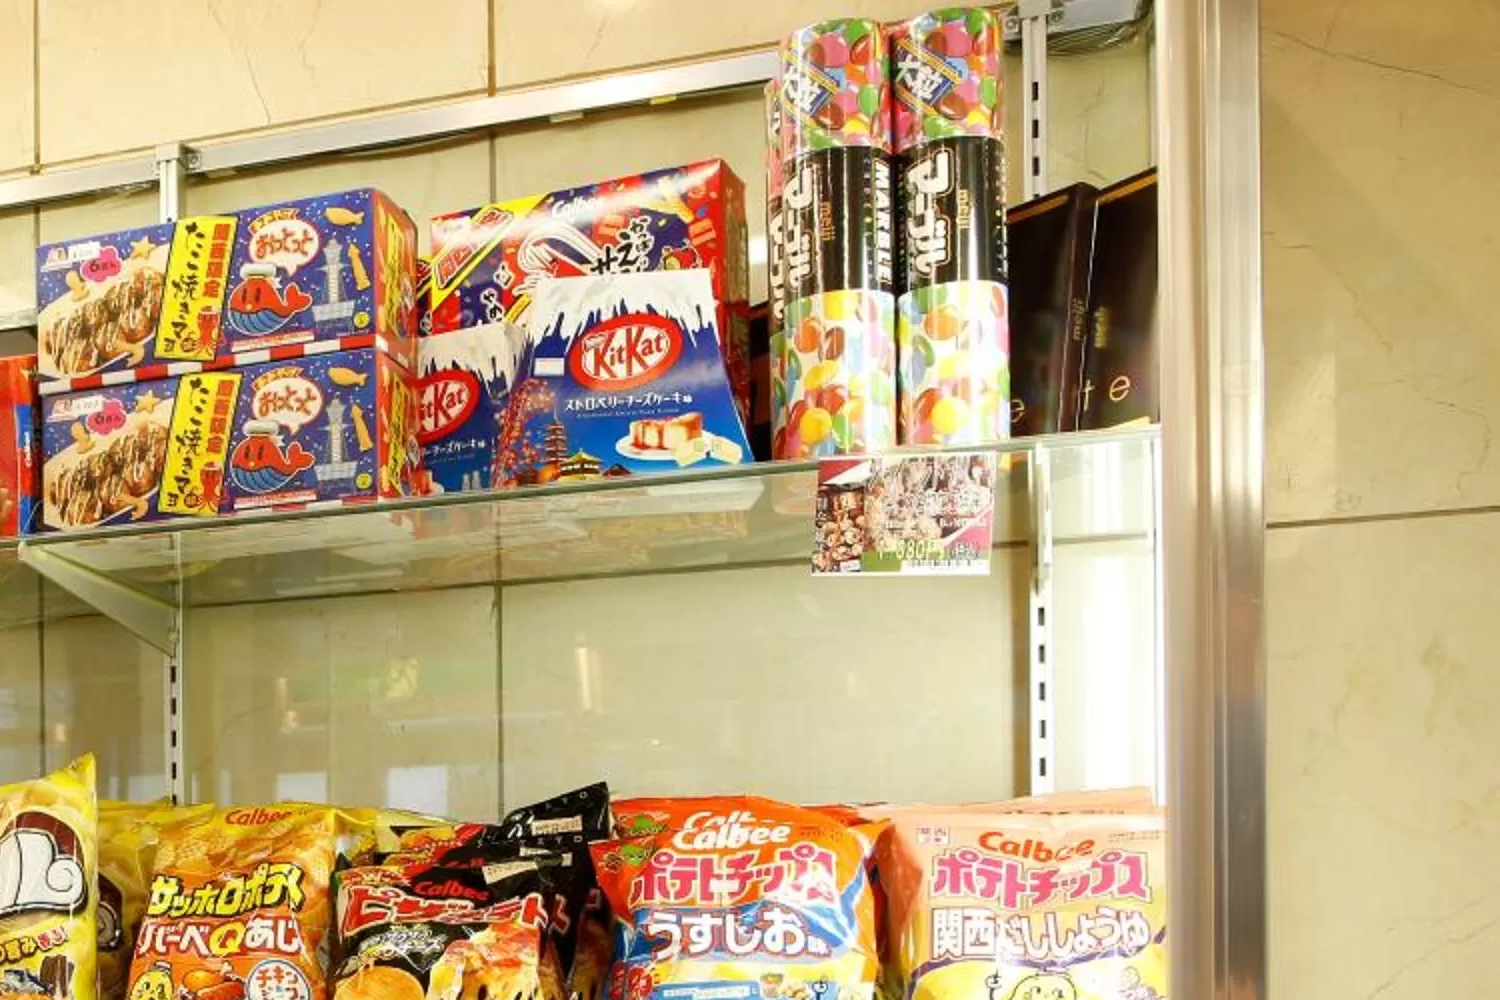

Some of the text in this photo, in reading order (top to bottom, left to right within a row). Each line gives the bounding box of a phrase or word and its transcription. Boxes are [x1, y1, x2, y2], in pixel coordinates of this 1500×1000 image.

[255, 226, 315, 259] おっとっと
[875, 159, 892, 284] MARBLE
[591, 327, 665, 378] KitKat
[225, 807, 293, 826] Calbee
[671, 822, 790, 850] Calbee
[978, 831, 1096, 862] Calbee
[148, 861, 306, 917] サッポロポテト
[628, 843, 837, 905] ポテトチップス
[931, 850, 1152, 909] ポテトチップス
[137, 916, 306, 957] バーベQあじ
